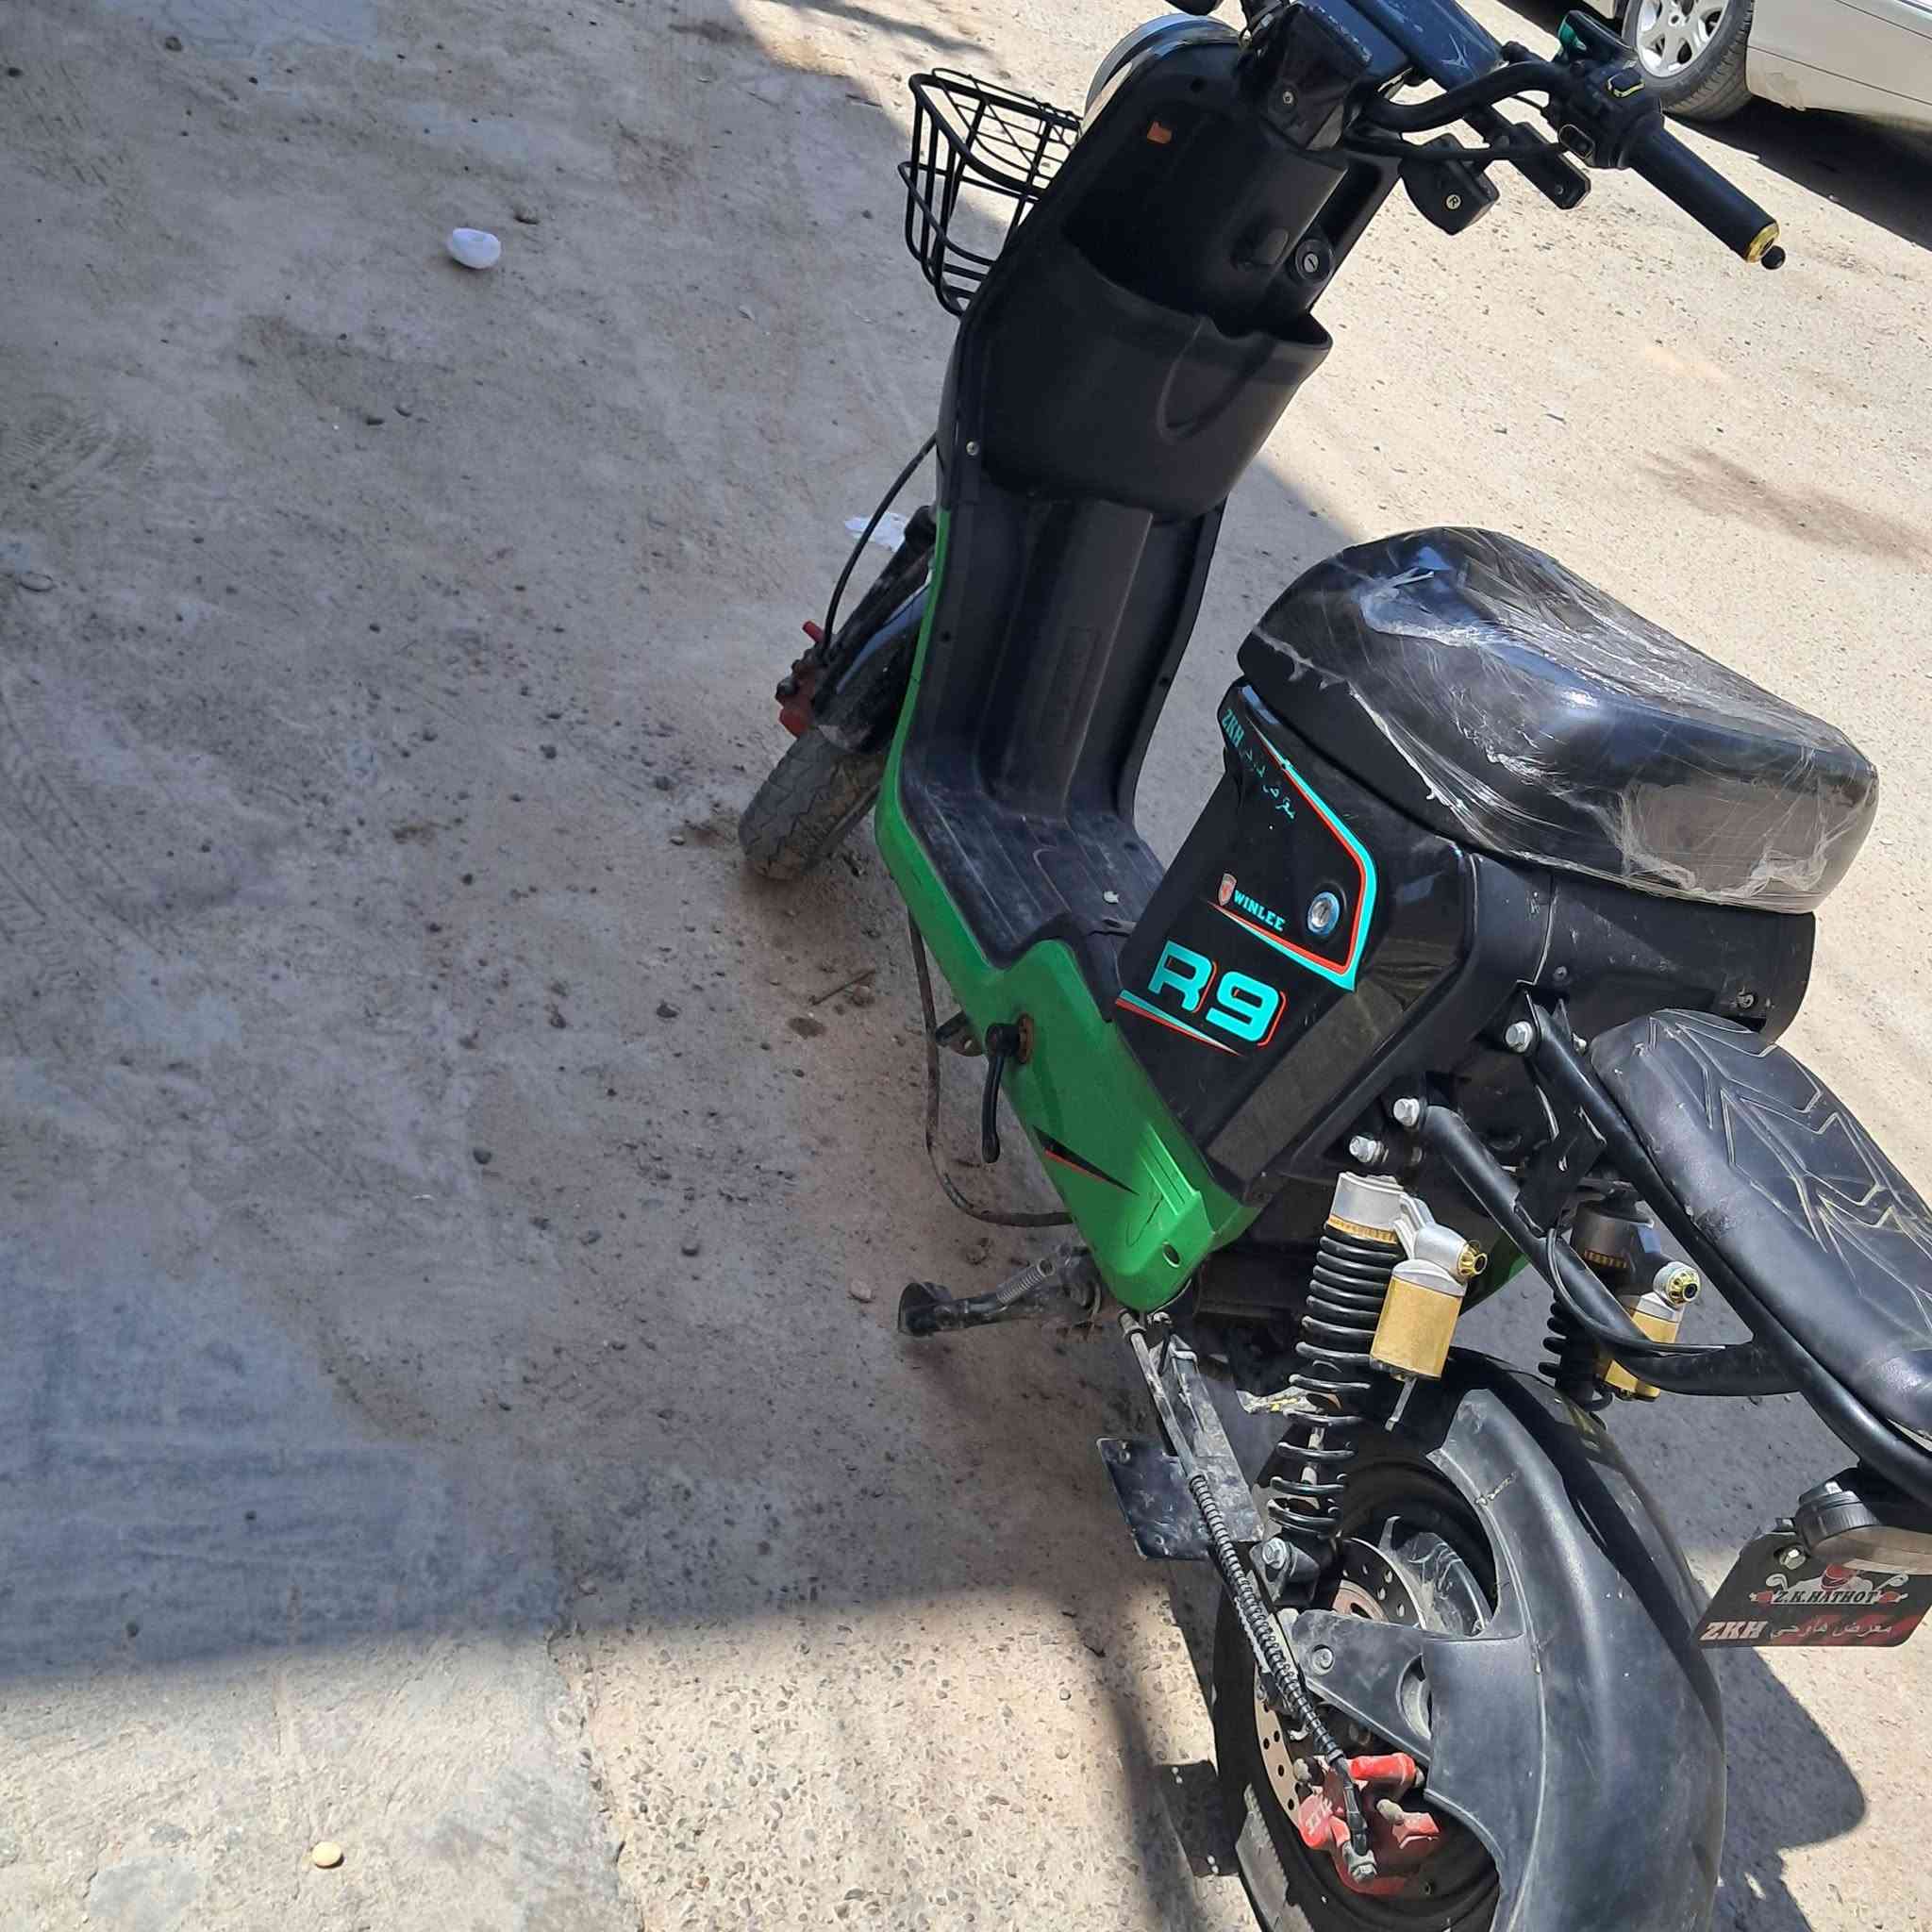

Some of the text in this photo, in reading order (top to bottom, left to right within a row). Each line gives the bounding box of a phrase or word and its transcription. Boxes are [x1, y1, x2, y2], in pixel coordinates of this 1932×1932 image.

[1234, 889, 1286, 932] WINLEE
[1147, 941, 1280, 1041] R9
[1699, 1621, 1769, 1641] ZKH
